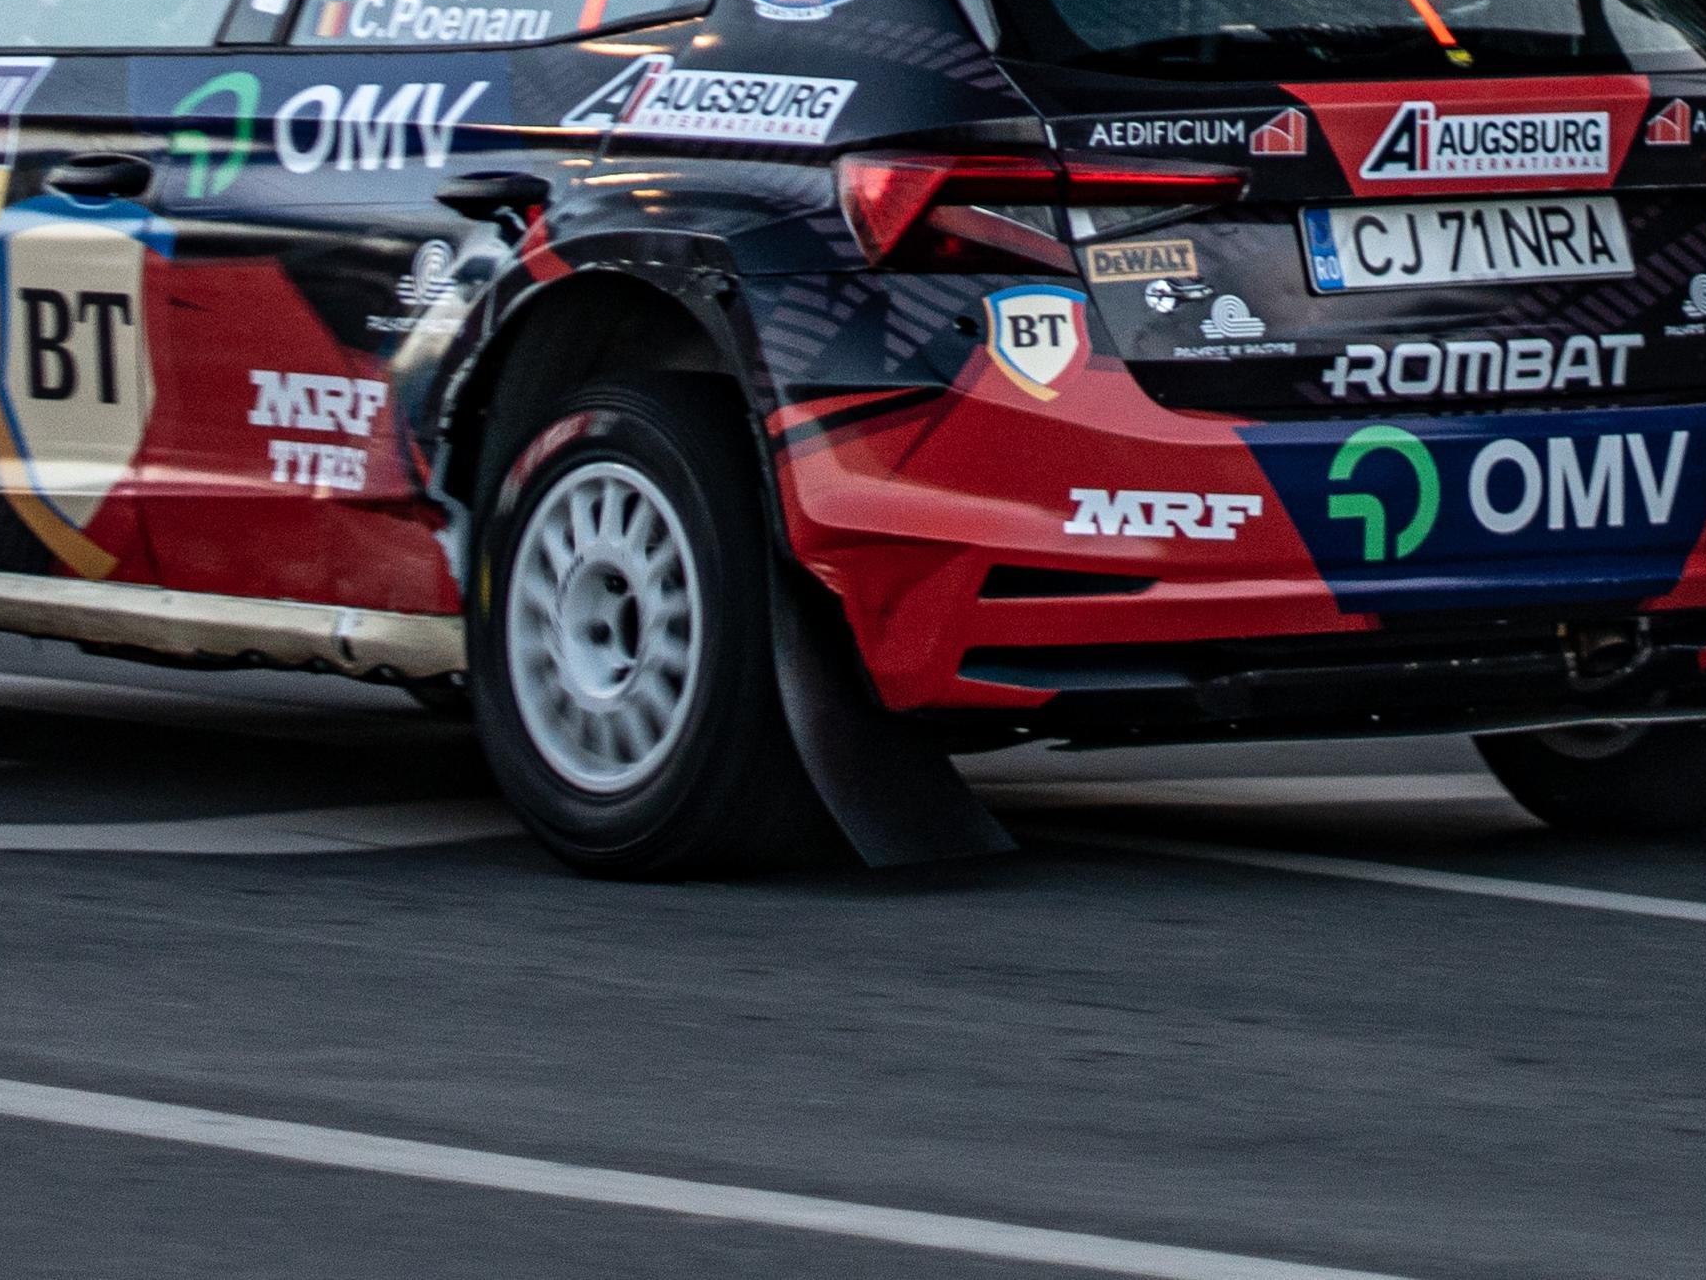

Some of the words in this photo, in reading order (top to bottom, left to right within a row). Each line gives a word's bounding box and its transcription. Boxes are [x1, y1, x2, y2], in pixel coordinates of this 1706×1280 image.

[648, 71, 841, 121] AUGSBURG
[273, 80, 491, 173] OMV
[620, 105, 825, 138] INTERNATIONAL
[1090, 118, 1245, 149] AEDIFICIUM
[1437, 118, 1601, 159] AUGSBURG
[1436, 156, 1603, 171] INTERNATIONAL
[20, 288, 132, 404] BT
[1008, 314, 1067, 348] BT
[1324, 335, 1644, 398] ROMBAT
[248, 371, 388, 435] MRF
[269, 442, 368, 492] TYRES
[1469, 431, 1689, 535] OMV
[1064, 488, 1262, 540] MRF
